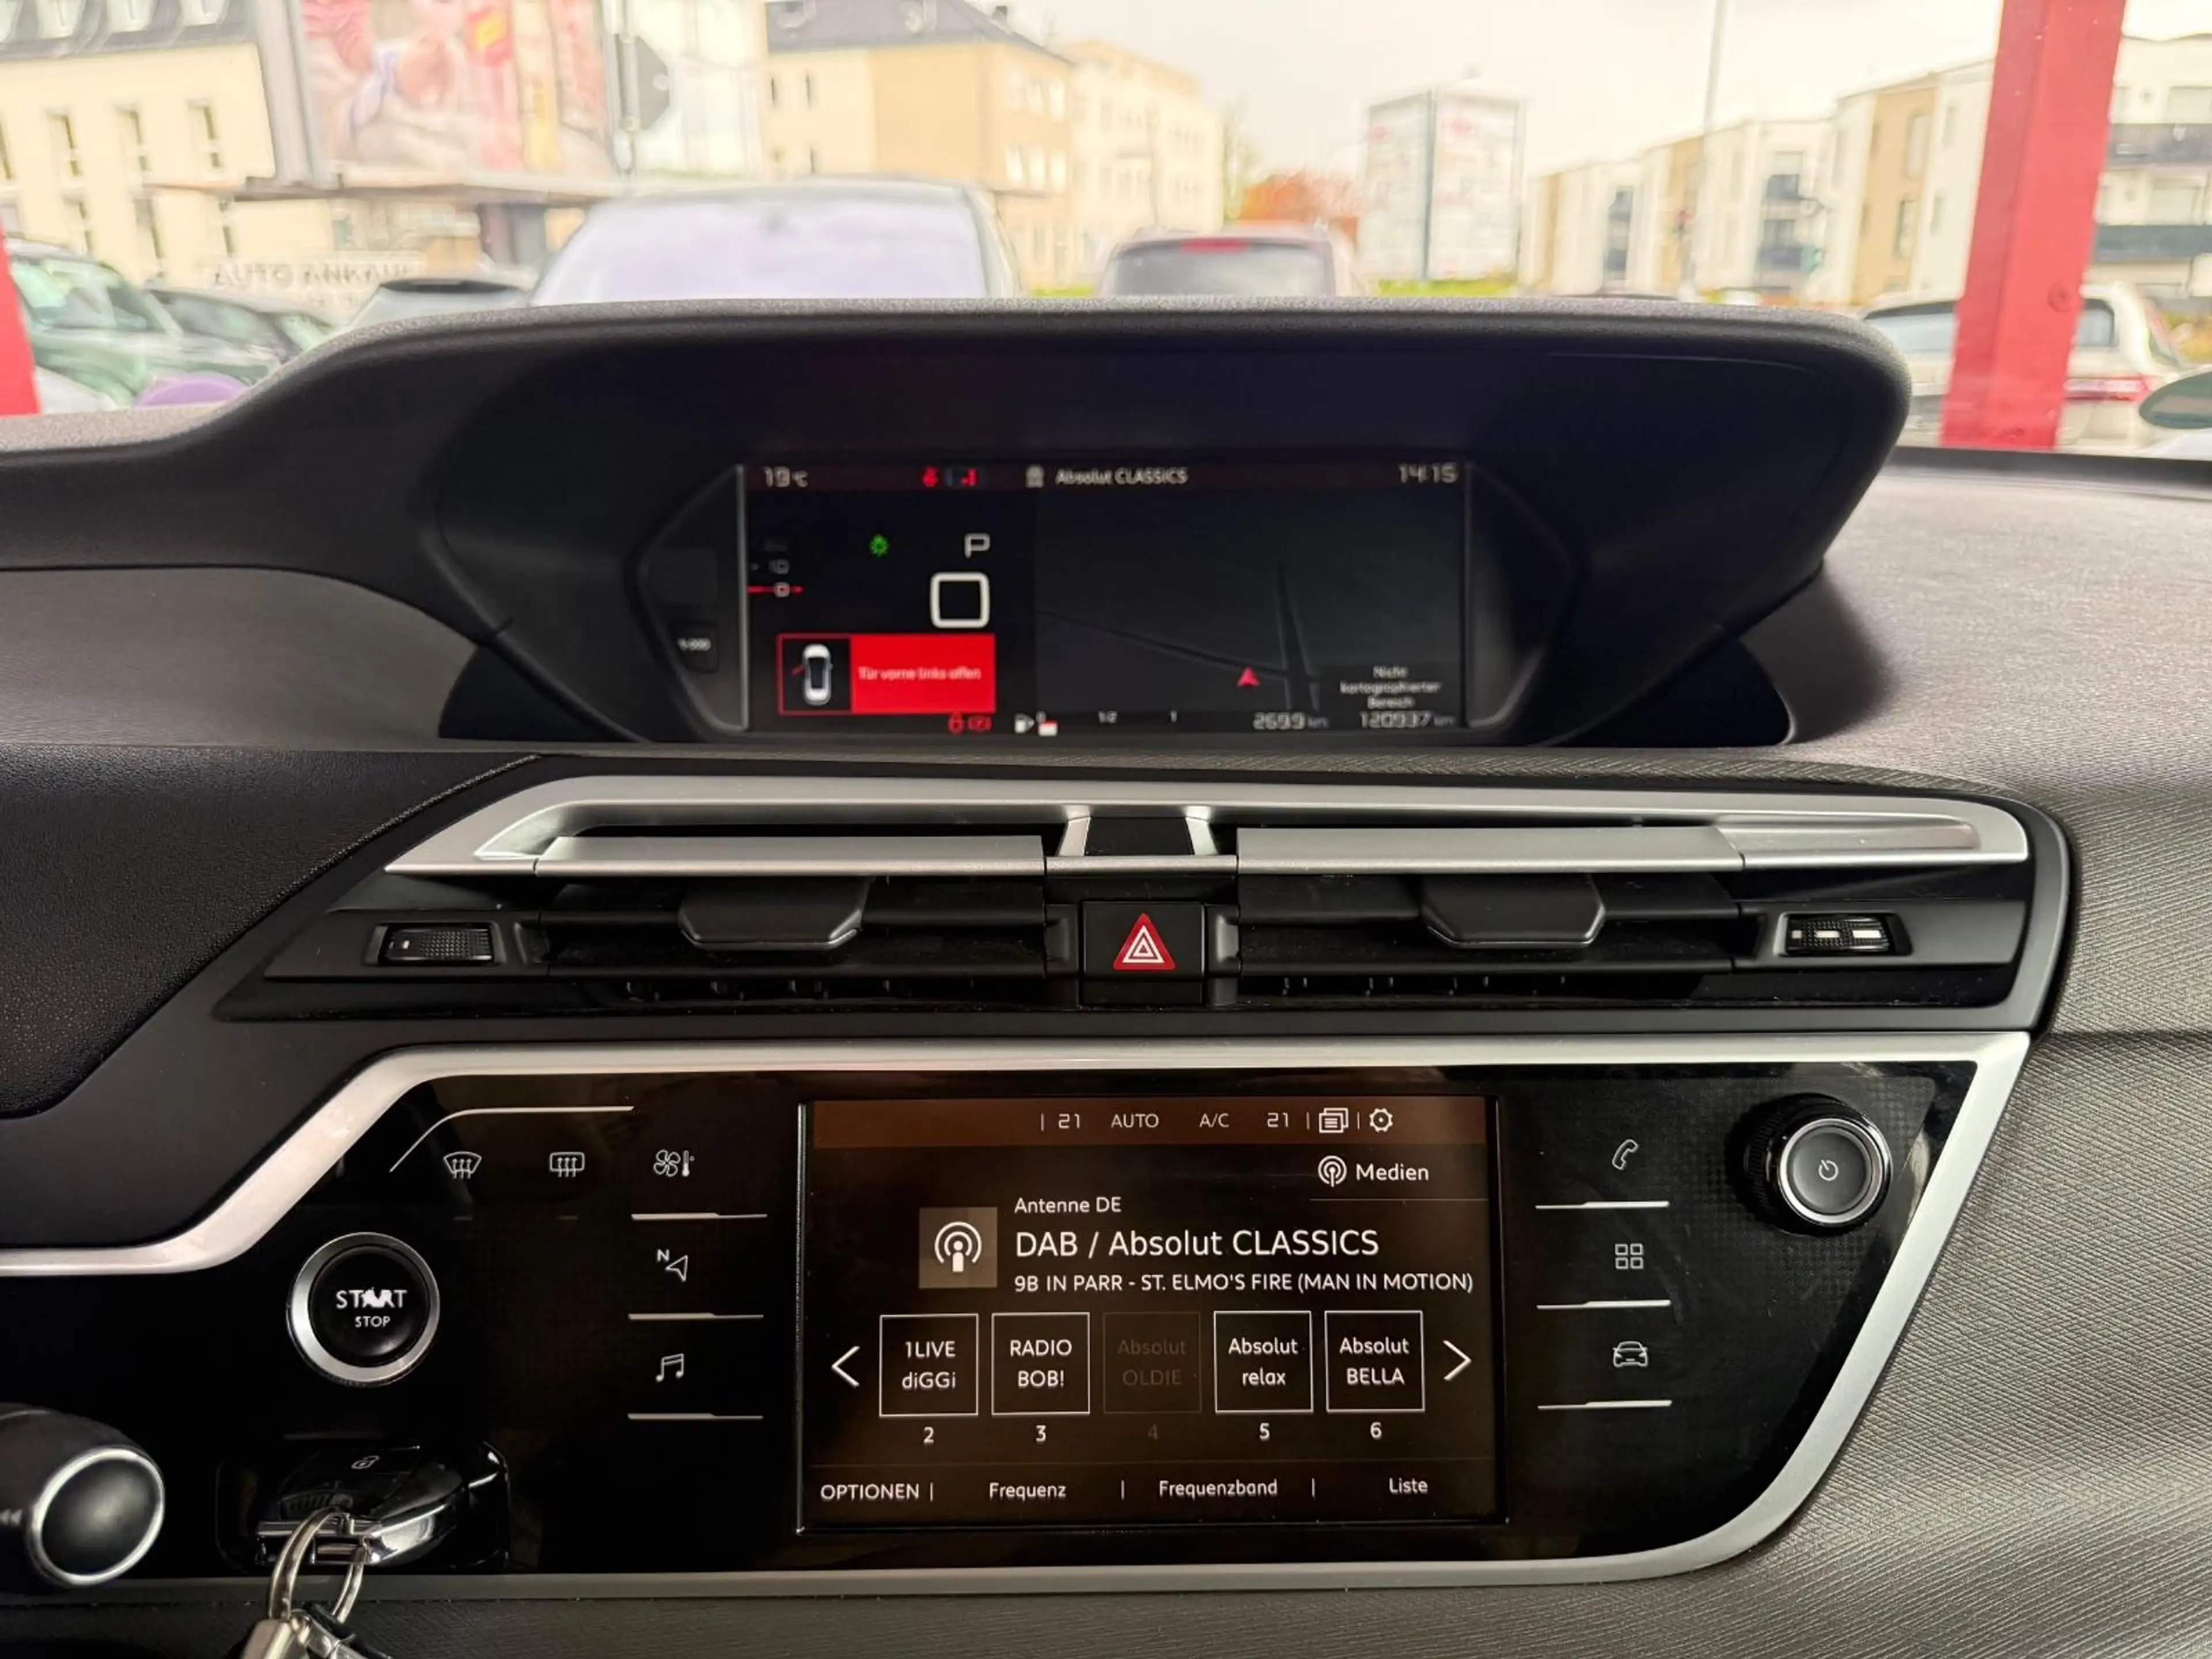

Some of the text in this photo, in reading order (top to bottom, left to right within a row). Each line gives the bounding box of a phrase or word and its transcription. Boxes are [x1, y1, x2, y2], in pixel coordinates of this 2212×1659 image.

[1114, 467, 1188, 485] CLASSICS
[1059, 1114, 1080, 1128] 21
[1112, 1113, 1159, 1127] AUTO
[1200, 1113, 1228, 1127] A/C
[1268, 1113, 1288, 1127] 21
[1357, 1164, 1429, 1180] Medien
[1015, 1197, 1121, 1213] Antenne DE
[1017, 1230, 1378, 1259] DAB / Absolut CLASSICS
[1015, 1276, 1038, 1291] 9B
[1047, 1275, 1066, 1291] IN
[1074, 1275, 1122, 1290] PARR
[1142, 1275, 1165, 1290] ST.
[1173, 1274, 1245, 1290] ELMO'S
[1252, 1274, 1291, 1290] FIRE
[1298, 1274, 1349, 1293] (MAN
[1357, 1274, 1376, 1289] IN
[1384, 1273, 1472, 1293] MOTION)
[355, 1316, 390, 1327] STOP
[906, 1341, 955, 1357] 1LIVE
[1010, 1340, 1071, 1356] RADIO
[1118, 1339, 1186, 1355] Absolut
[1229, 1338, 1297, 1354] Absolut
[1340, 1337, 1408, 1354] Absolut
[903, 1372, 955, 1388] diGGi
[1018, 1370, 1063, 1387] BOB!
[1122, 1369, 1183, 1386] OLDIE
[1243, 1368, 1285, 1385] relax
[1347, 1368, 1404, 1384] BELLA
[924, 1427, 933, 1443] 2
[1036, 1425, 1046, 1441] 3
[1260, 1423, 1270, 1440] 5
[1370, 1422, 1381, 1438] 6
[821, 1484, 918, 1499] OPTIONEN
[990, 1483, 1066, 1501] Frequenz
[1160, 1479, 1277, 1499] Frequenzband
[1389, 1478, 1427, 1493] Liste
